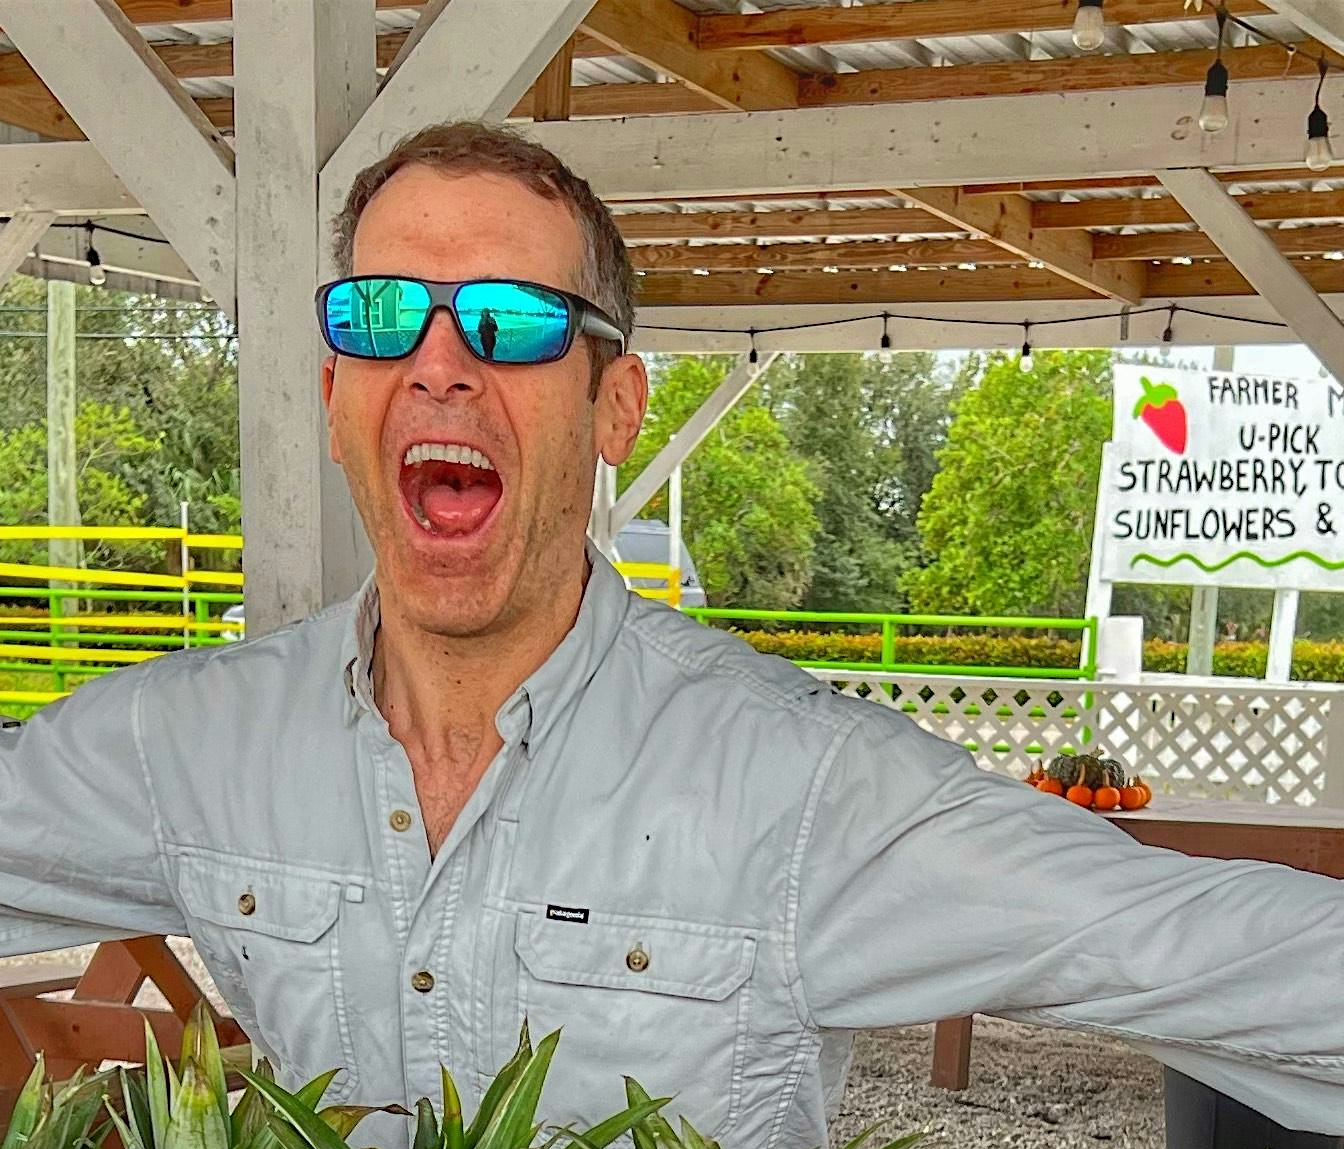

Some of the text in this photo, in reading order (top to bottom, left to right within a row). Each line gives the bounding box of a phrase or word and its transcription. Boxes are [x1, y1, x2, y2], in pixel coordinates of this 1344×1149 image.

[1208, 377, 1299, 410] FARMER
[1239, 423, 1321, 455] U-PICK
[1118, 457, 1307, 497] STRAWBERRY,
[1113, 507, 1296, 541] SUNFLOWERS
[1315, 502, 1339, 536] &
